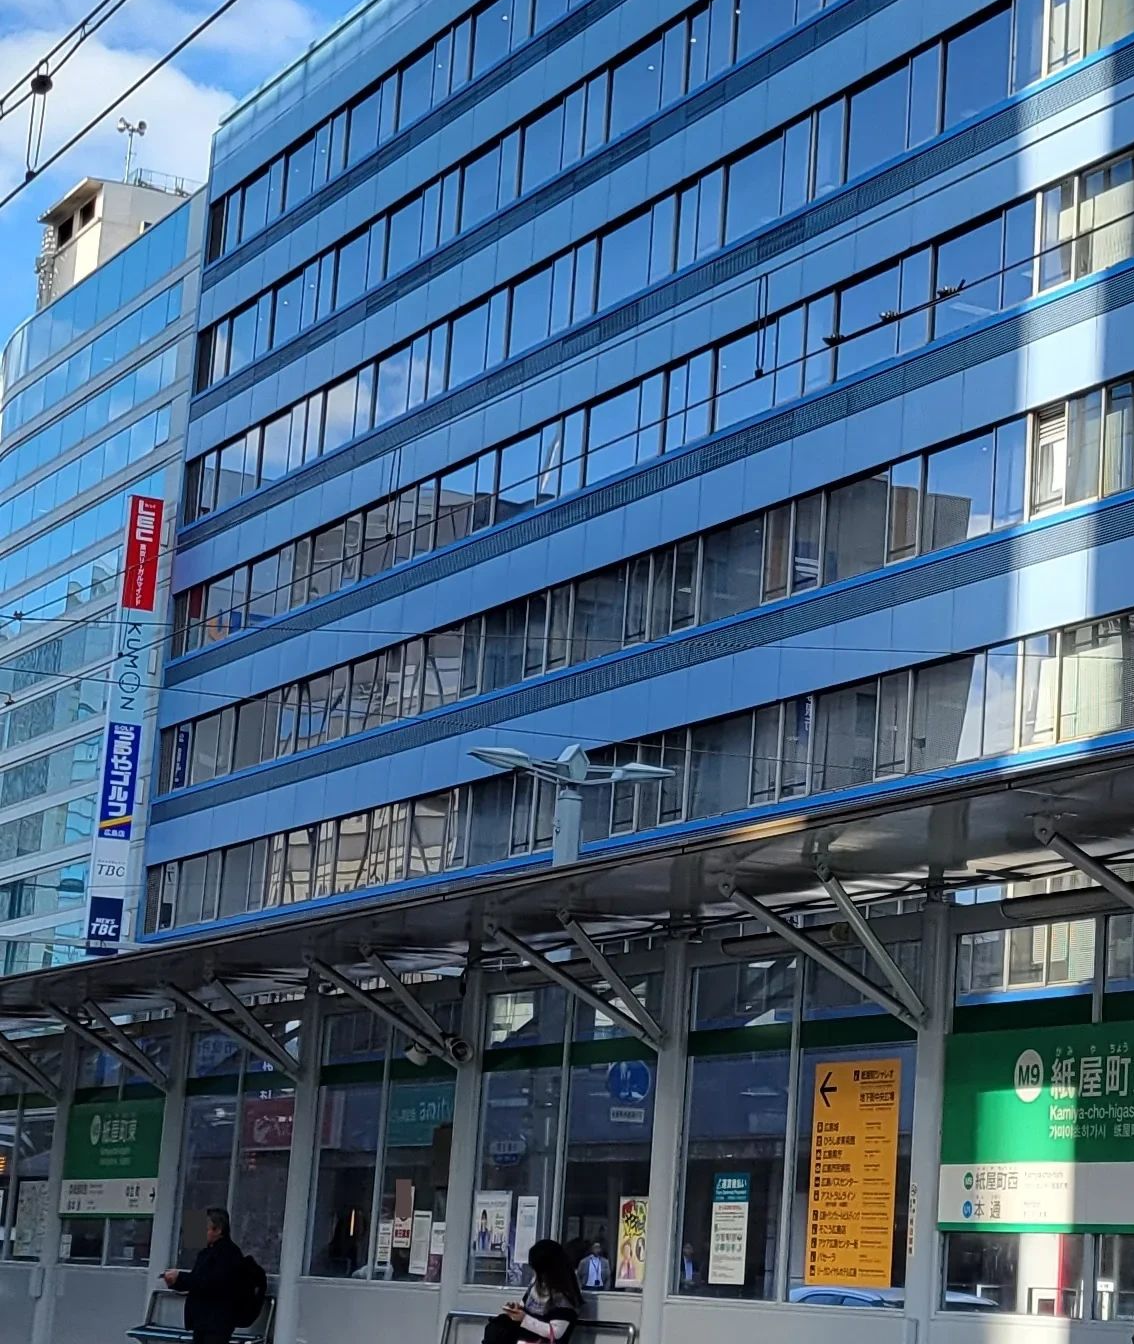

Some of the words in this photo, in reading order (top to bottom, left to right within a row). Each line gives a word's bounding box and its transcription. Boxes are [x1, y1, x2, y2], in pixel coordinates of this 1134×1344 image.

[136, 500, 156, 543] LEC
[119, 623, 142, 710] KUMON
[97, 864, 125, 877] TBC
[91, 923, 119, 936] TBC
[1110, 1042, 1128, 1053] ちょう
[1018, 1064, 1040, 1086] M9
[975, 1172, 1018, 1190] 紙屋町西
[974, 1201, 1000, 1219] 本通
